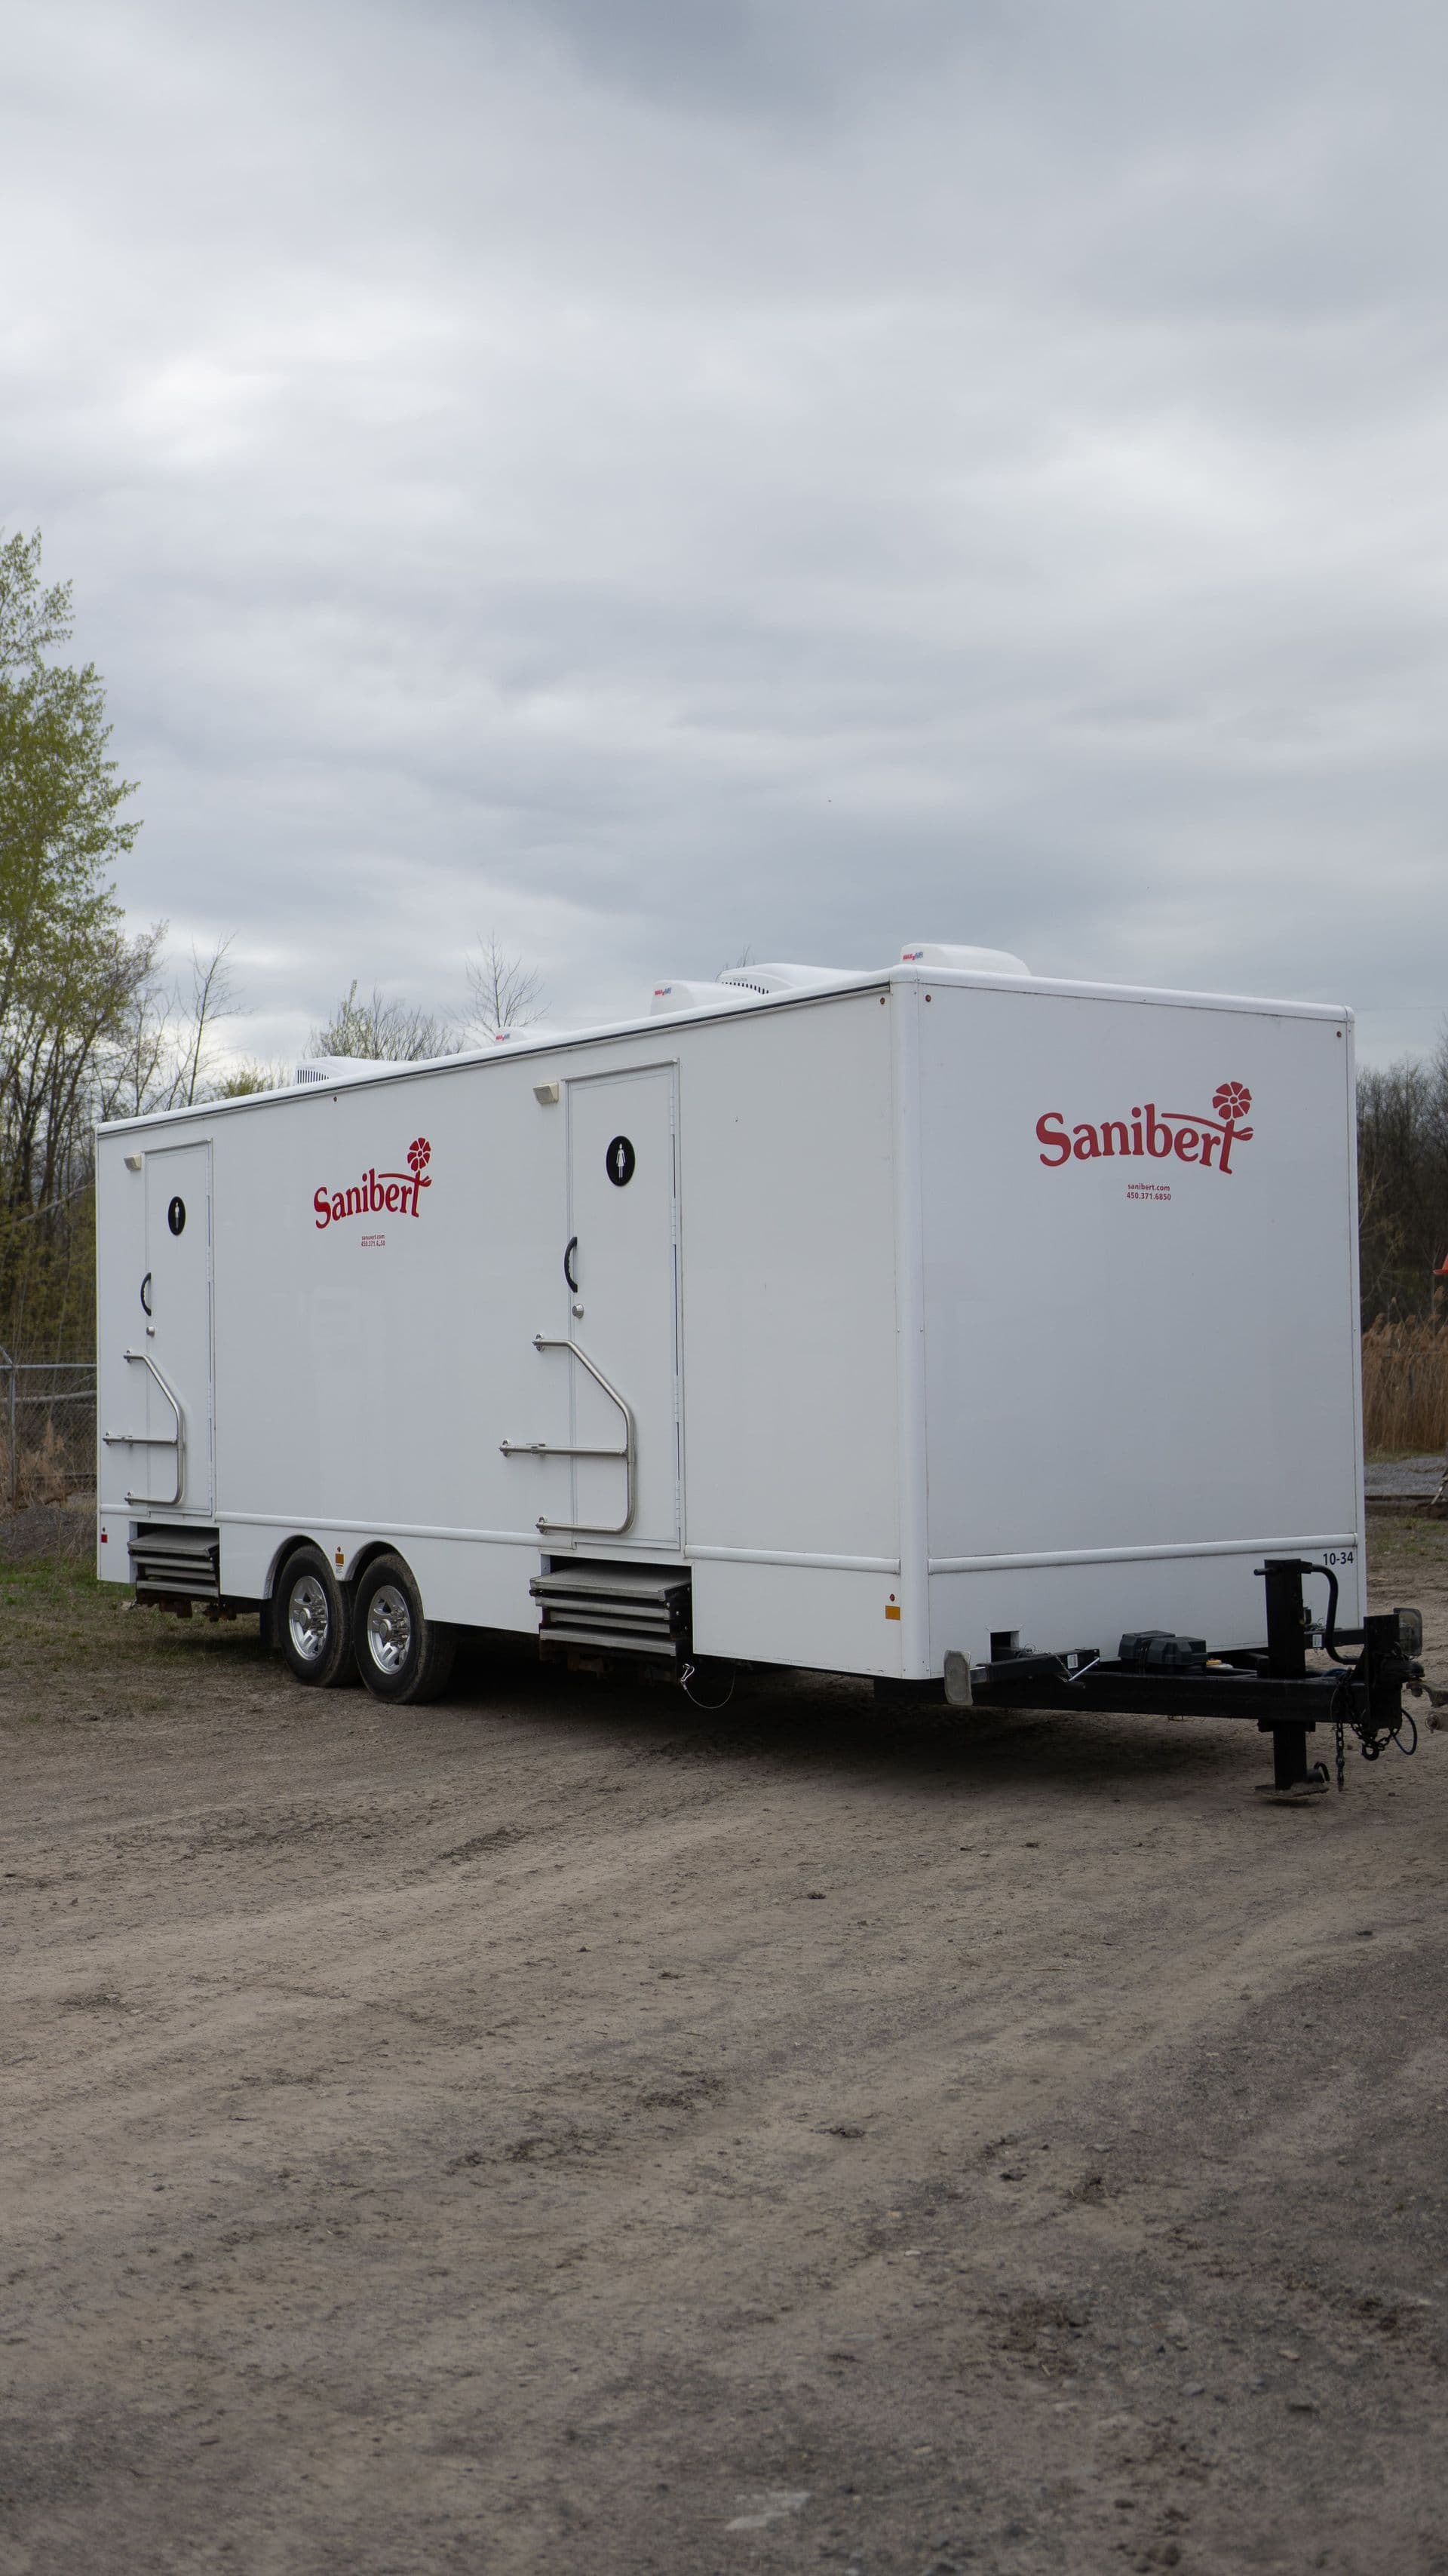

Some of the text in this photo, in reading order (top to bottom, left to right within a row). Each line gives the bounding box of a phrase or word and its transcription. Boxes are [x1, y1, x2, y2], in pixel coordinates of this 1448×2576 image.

[1035, 1102, 1253, 1175] Sanibert
[1127, 1183, 1170, 1191] sanibert.com
[313, 1167, 432, 1230] Sanibert
[1127, 1192, 1171, 1201] 450.371.6850
[1323, 1551, 1354, 1566] 10-34
